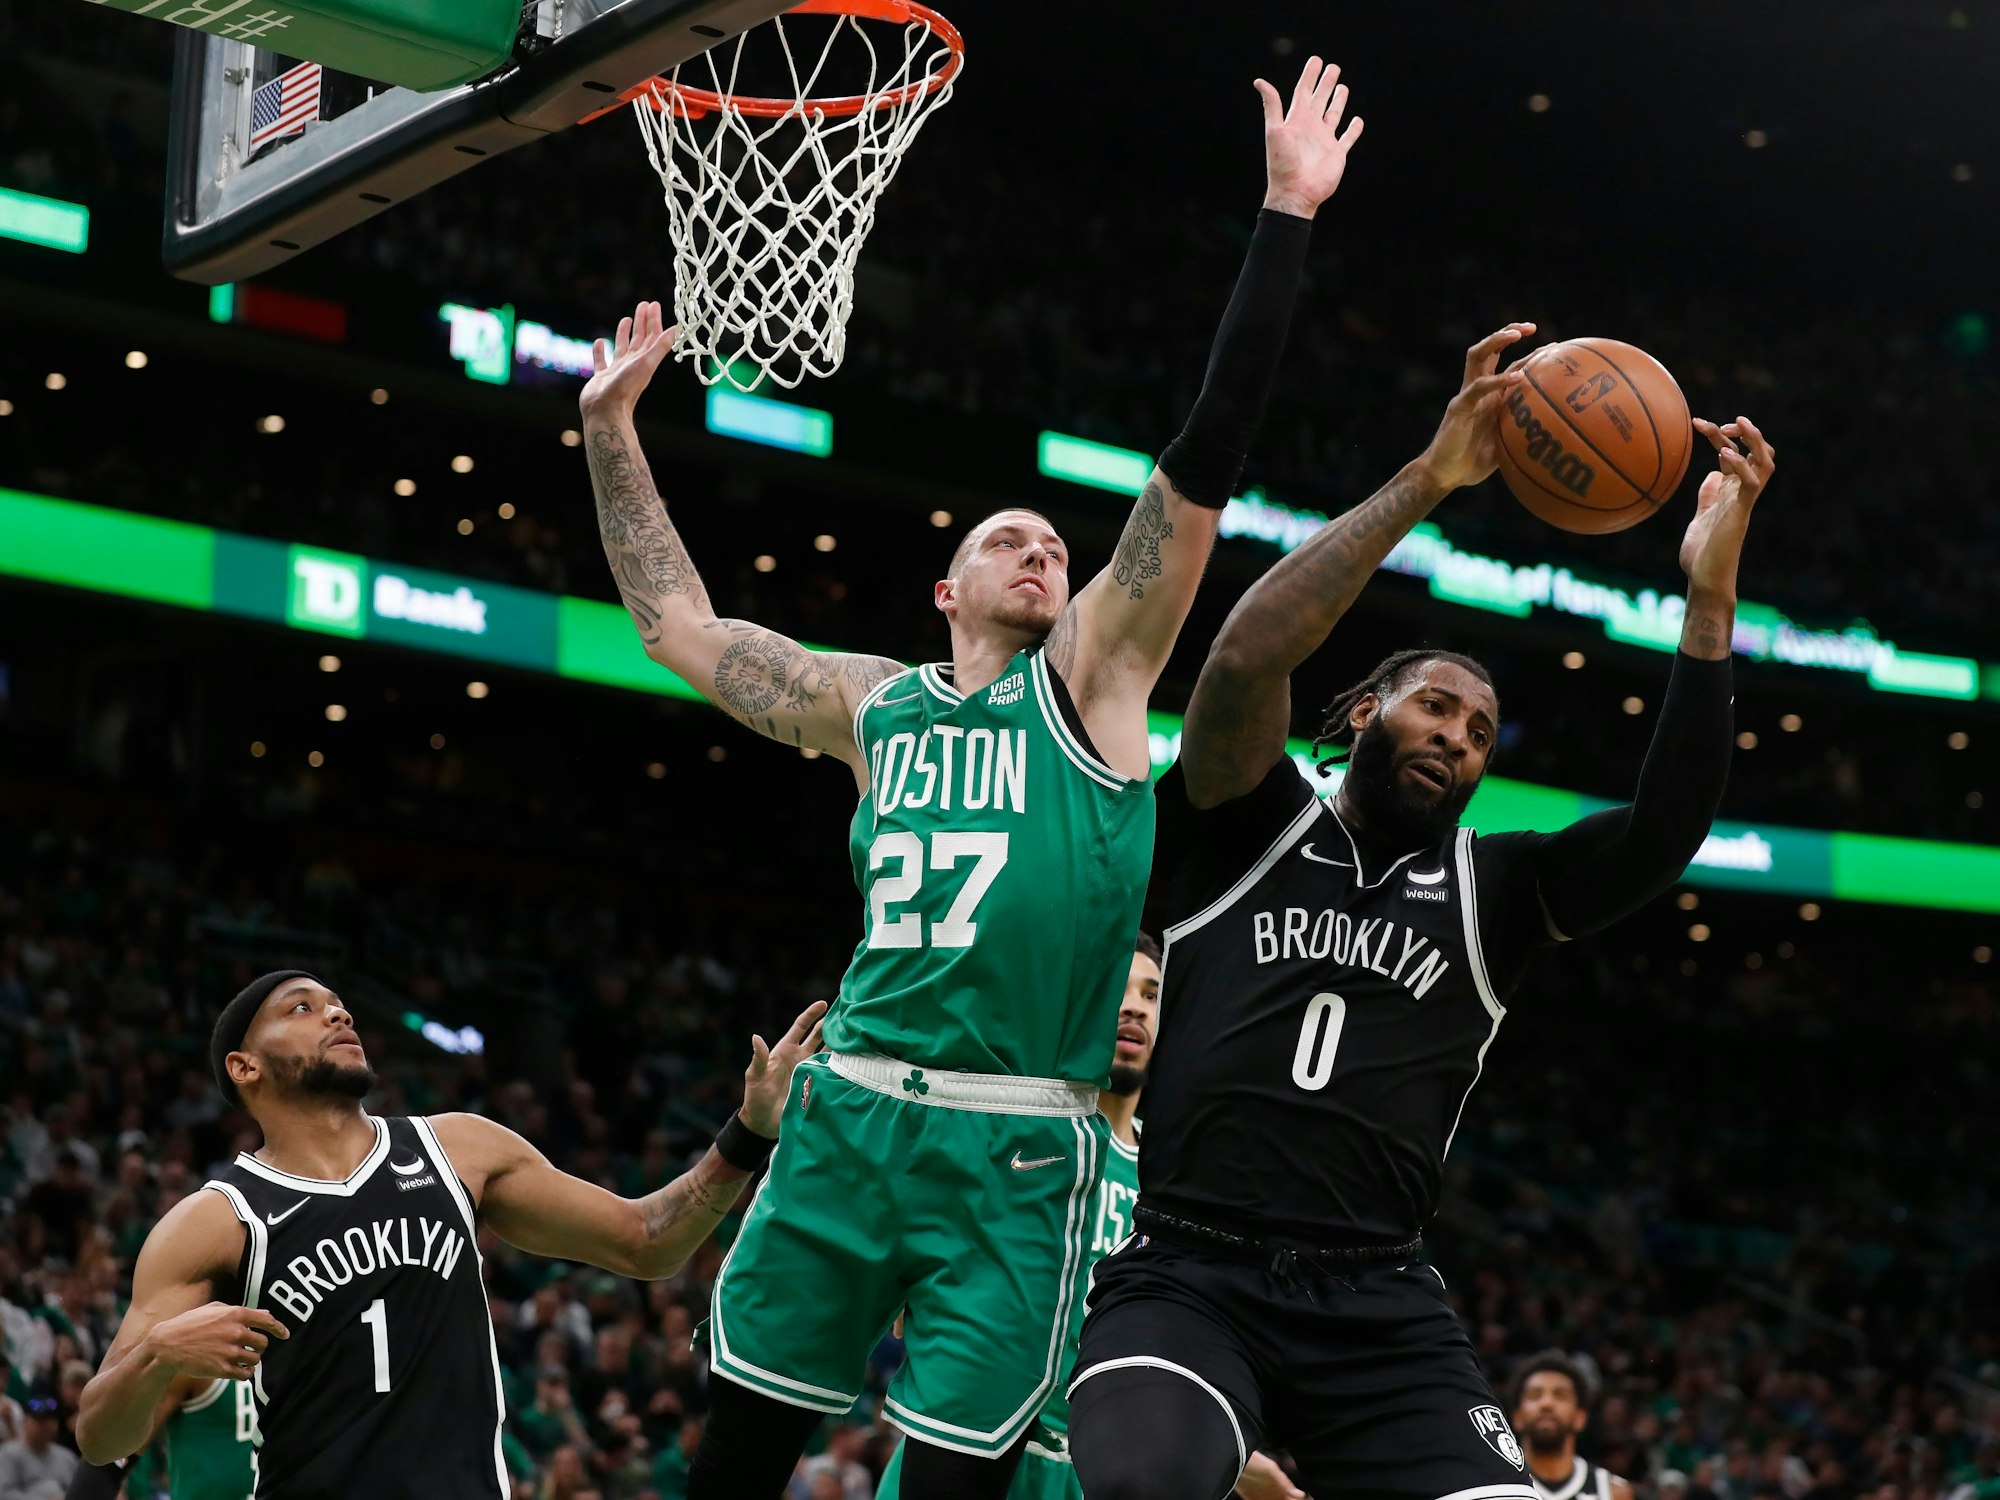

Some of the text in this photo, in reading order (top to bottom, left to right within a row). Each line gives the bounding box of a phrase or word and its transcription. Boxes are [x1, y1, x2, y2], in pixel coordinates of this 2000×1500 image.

[1507, 386, 1595, 498] Wilson
[294, 555, 487, 635] TD Bank
[987, 686, 1026, 706] PRINT
[990, 672, 1025, 697] VISTA
[867, 831, 1010, 949] 27
[1253, 907, 1450, 1001] BROOKLYN
[1291, 992, 1346, 1091] 0
[267, 1216, 465, 1323] BROOKLYN
[360, 1298, 391, 1393] 1
[1474, 1408, 1510, 1435] NET
